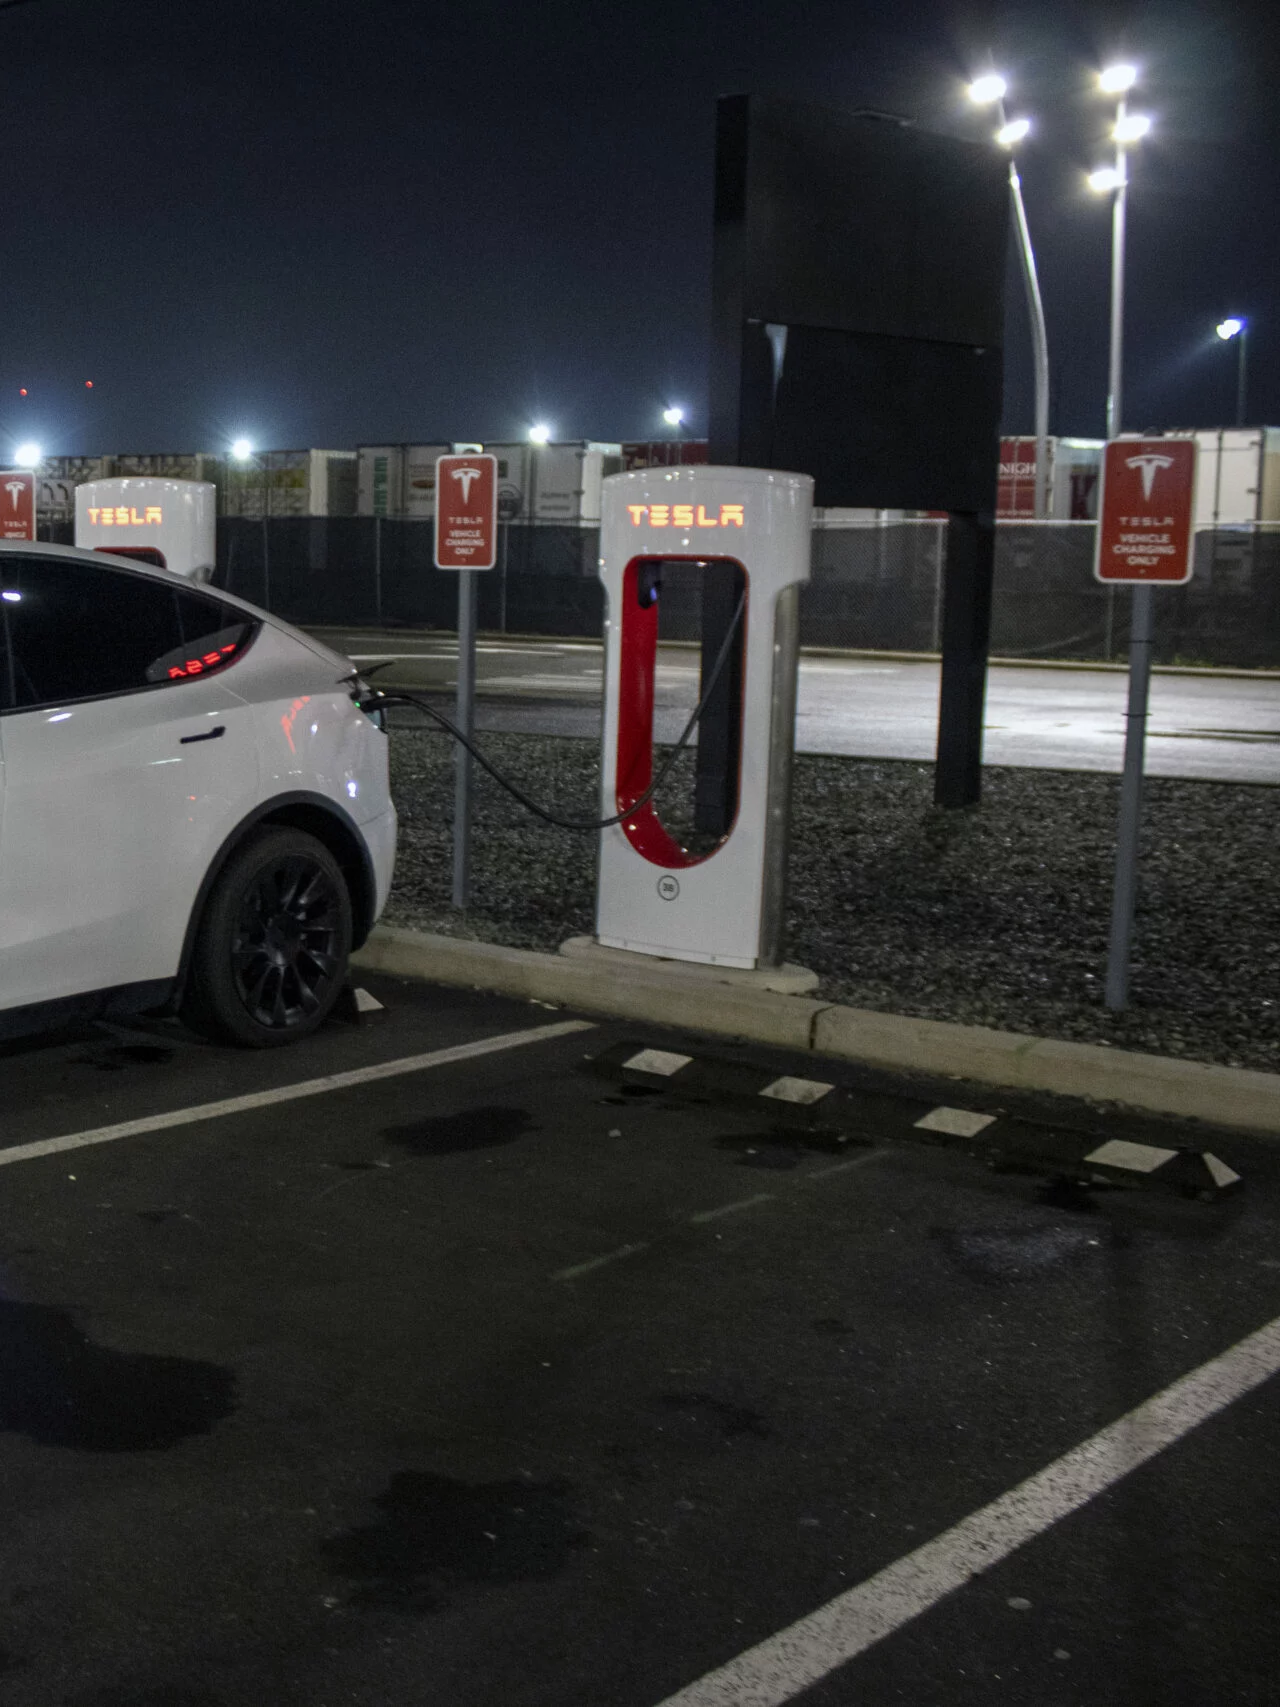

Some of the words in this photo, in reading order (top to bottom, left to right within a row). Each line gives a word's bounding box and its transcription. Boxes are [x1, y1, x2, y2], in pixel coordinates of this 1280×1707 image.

[1000, 463, 1037, 475] NIGH
[87, 506, 163, 526] TESLA
[448, 516, 483, 524] TESLA
[626, 504, 745, 528] TESLA
[1119, 516, 1175, 526] TESLA
[449, 529, 482, 538] VEHICLE
[1120, 533, 1171, 543] VEHICLE
[1112, 544, 1176, 555] CHARGING
[1127, 556, 1160, 566] ONLY
